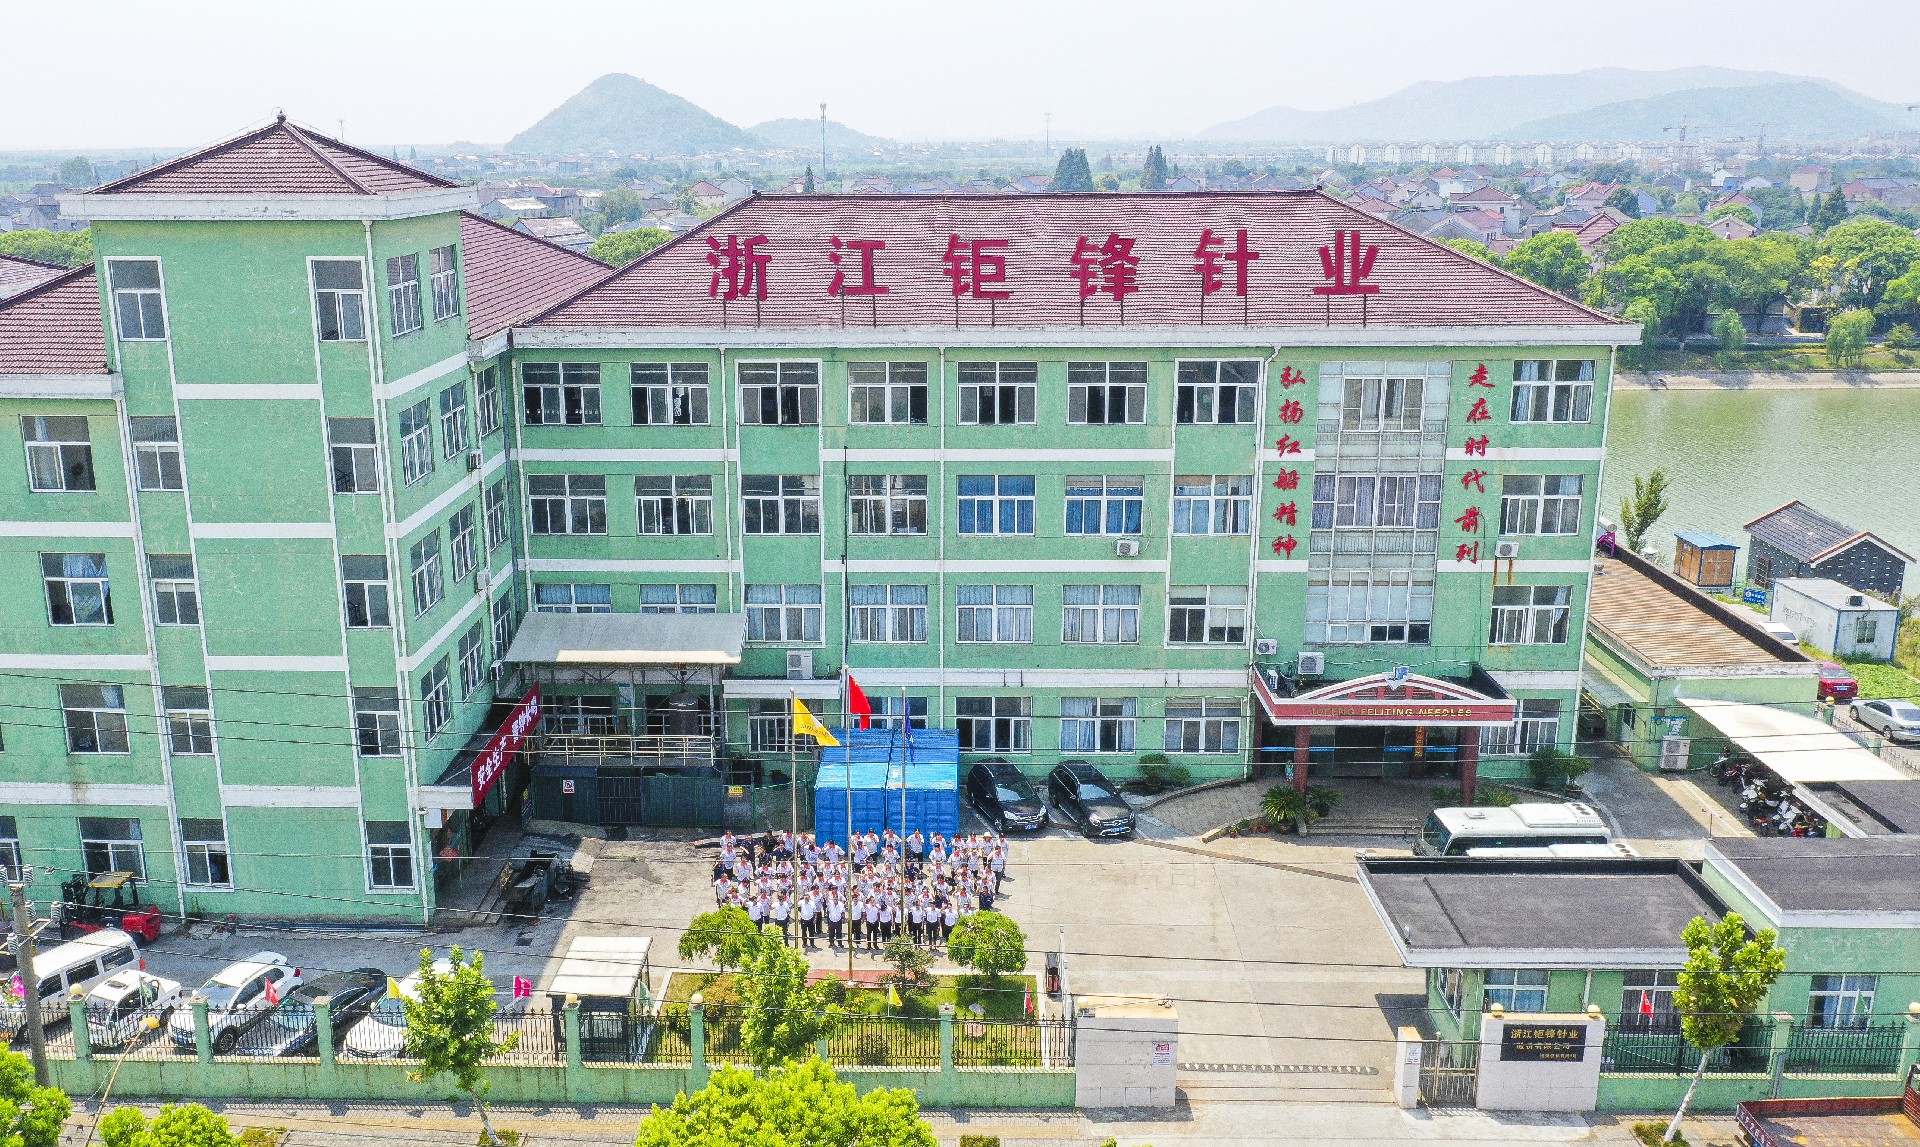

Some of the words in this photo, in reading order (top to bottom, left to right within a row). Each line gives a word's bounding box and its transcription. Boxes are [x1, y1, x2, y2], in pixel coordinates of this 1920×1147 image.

[706, 228, 1380, 300] 浙江钜锋针业
[1272, 366, 1306, 559] 弘扬红船精神
[1454, 363, 1495, 564] 走在时代前列
[1418, 708, 1472, 717] NEEDLES
